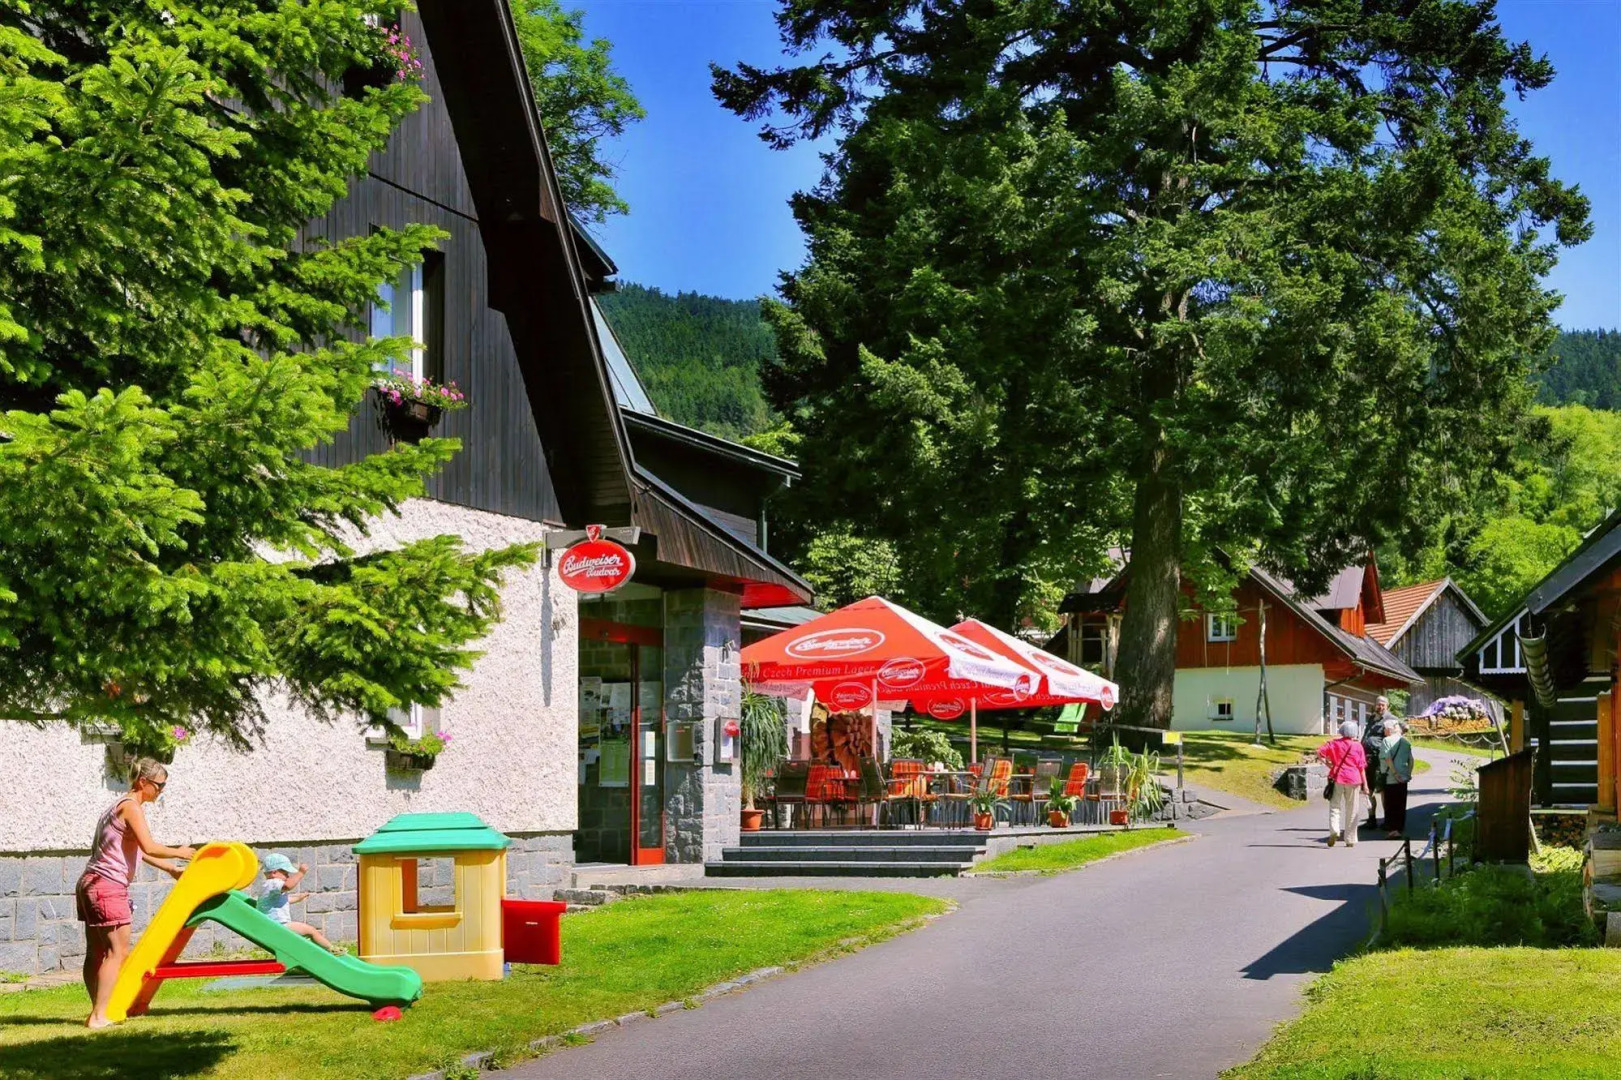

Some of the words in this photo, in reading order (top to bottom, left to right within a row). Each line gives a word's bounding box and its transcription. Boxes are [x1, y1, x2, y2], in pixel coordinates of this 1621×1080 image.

[563, 554, 623, 577] Budweiser
[763, 666, 792, 678] Czech
[795, 663, 840, 676] Premium
[844, 663, 876, 675] Lager
